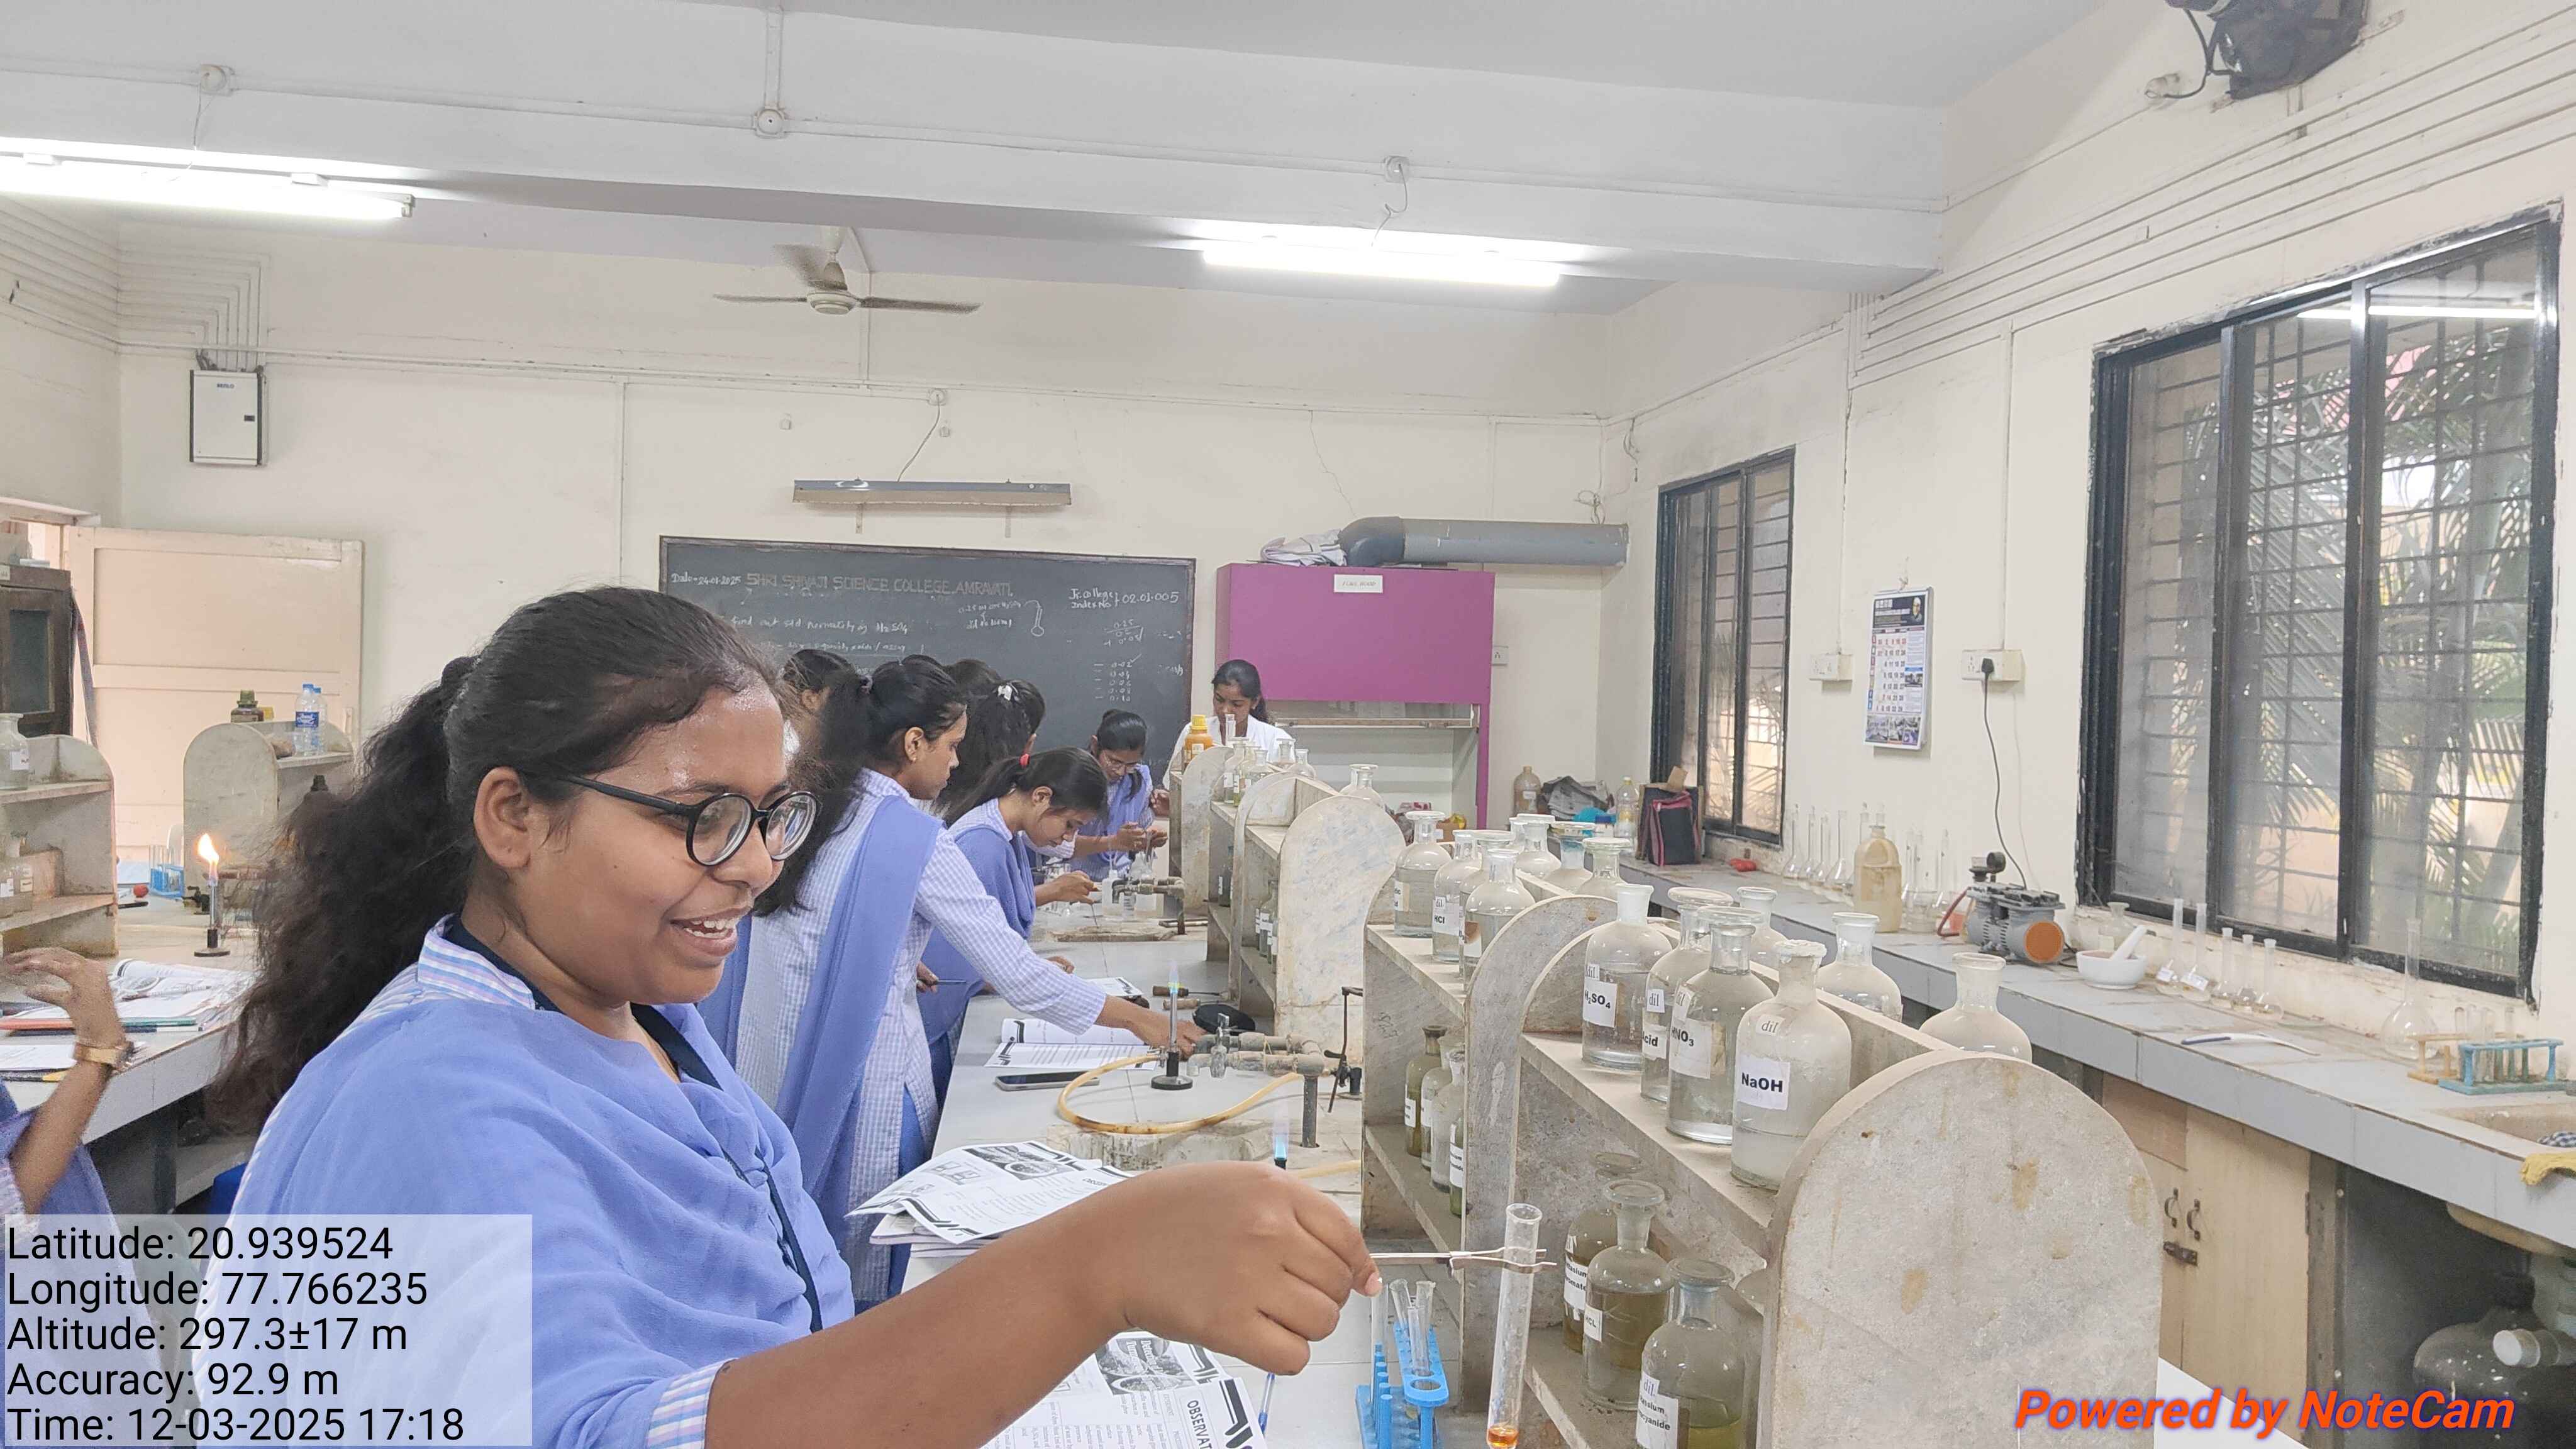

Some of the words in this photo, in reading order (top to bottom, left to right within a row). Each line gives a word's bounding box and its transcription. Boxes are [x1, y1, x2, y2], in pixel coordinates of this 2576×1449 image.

[747, 573, 777, 587] SHRI
[833, 576, 889, 591] SCIENCE
[1649, 993, 1660, 1007] dil
[1761, 1021, 1779, 1033] dil
[1741, 1072, 1784, 1093] NaOH
